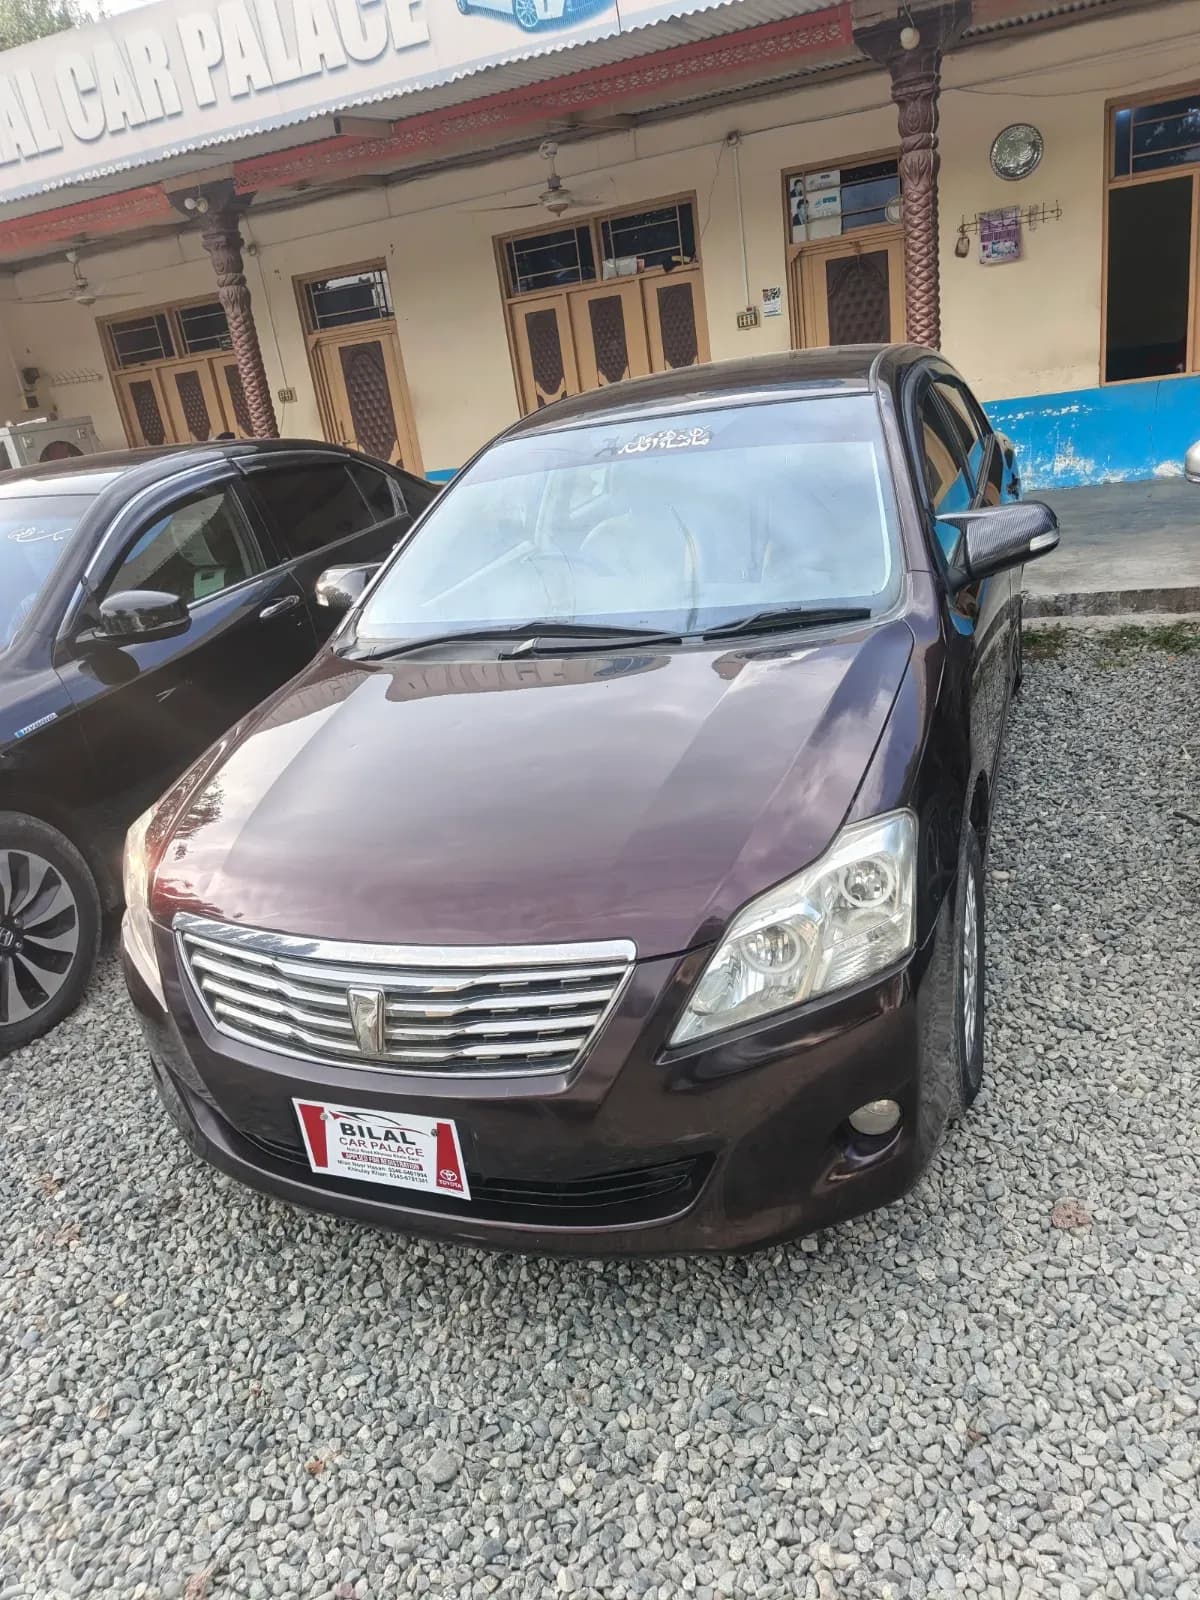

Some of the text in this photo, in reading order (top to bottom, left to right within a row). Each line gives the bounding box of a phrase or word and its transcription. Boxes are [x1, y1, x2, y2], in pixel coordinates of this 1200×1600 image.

[54, 30, 183, 143] CAR
[340, 1122, 416, 1146] BILAL
[339, 1137, 368, 1148] CAR
[370, 1141, 424, 1157] PALACE
[438, 1179, 462, 1189] TOYOTA
